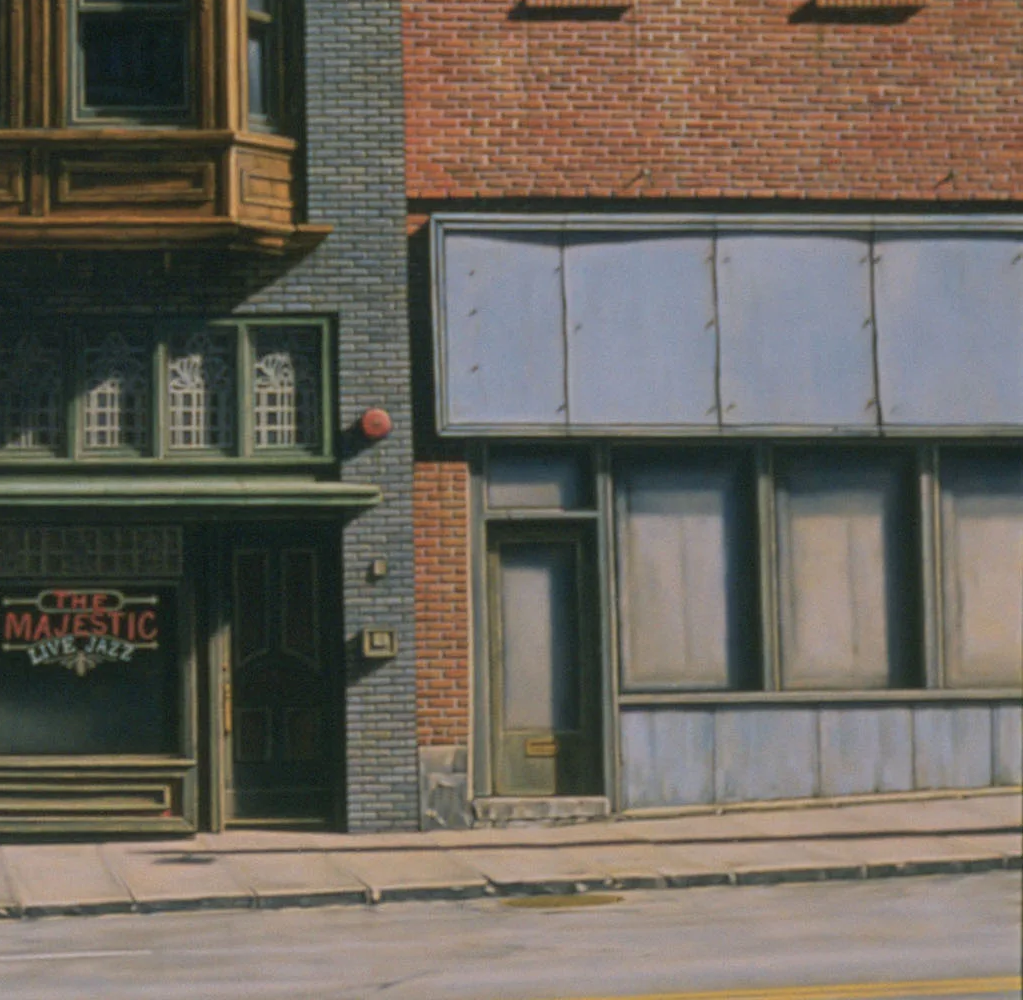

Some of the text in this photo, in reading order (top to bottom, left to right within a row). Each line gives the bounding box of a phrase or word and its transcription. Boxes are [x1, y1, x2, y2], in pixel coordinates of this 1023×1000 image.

[52, 590, 108, 613] THE
[4, 611, 158, 641] MAJESTIC
[28, 635, 136, 666] LIVE JAZZ
